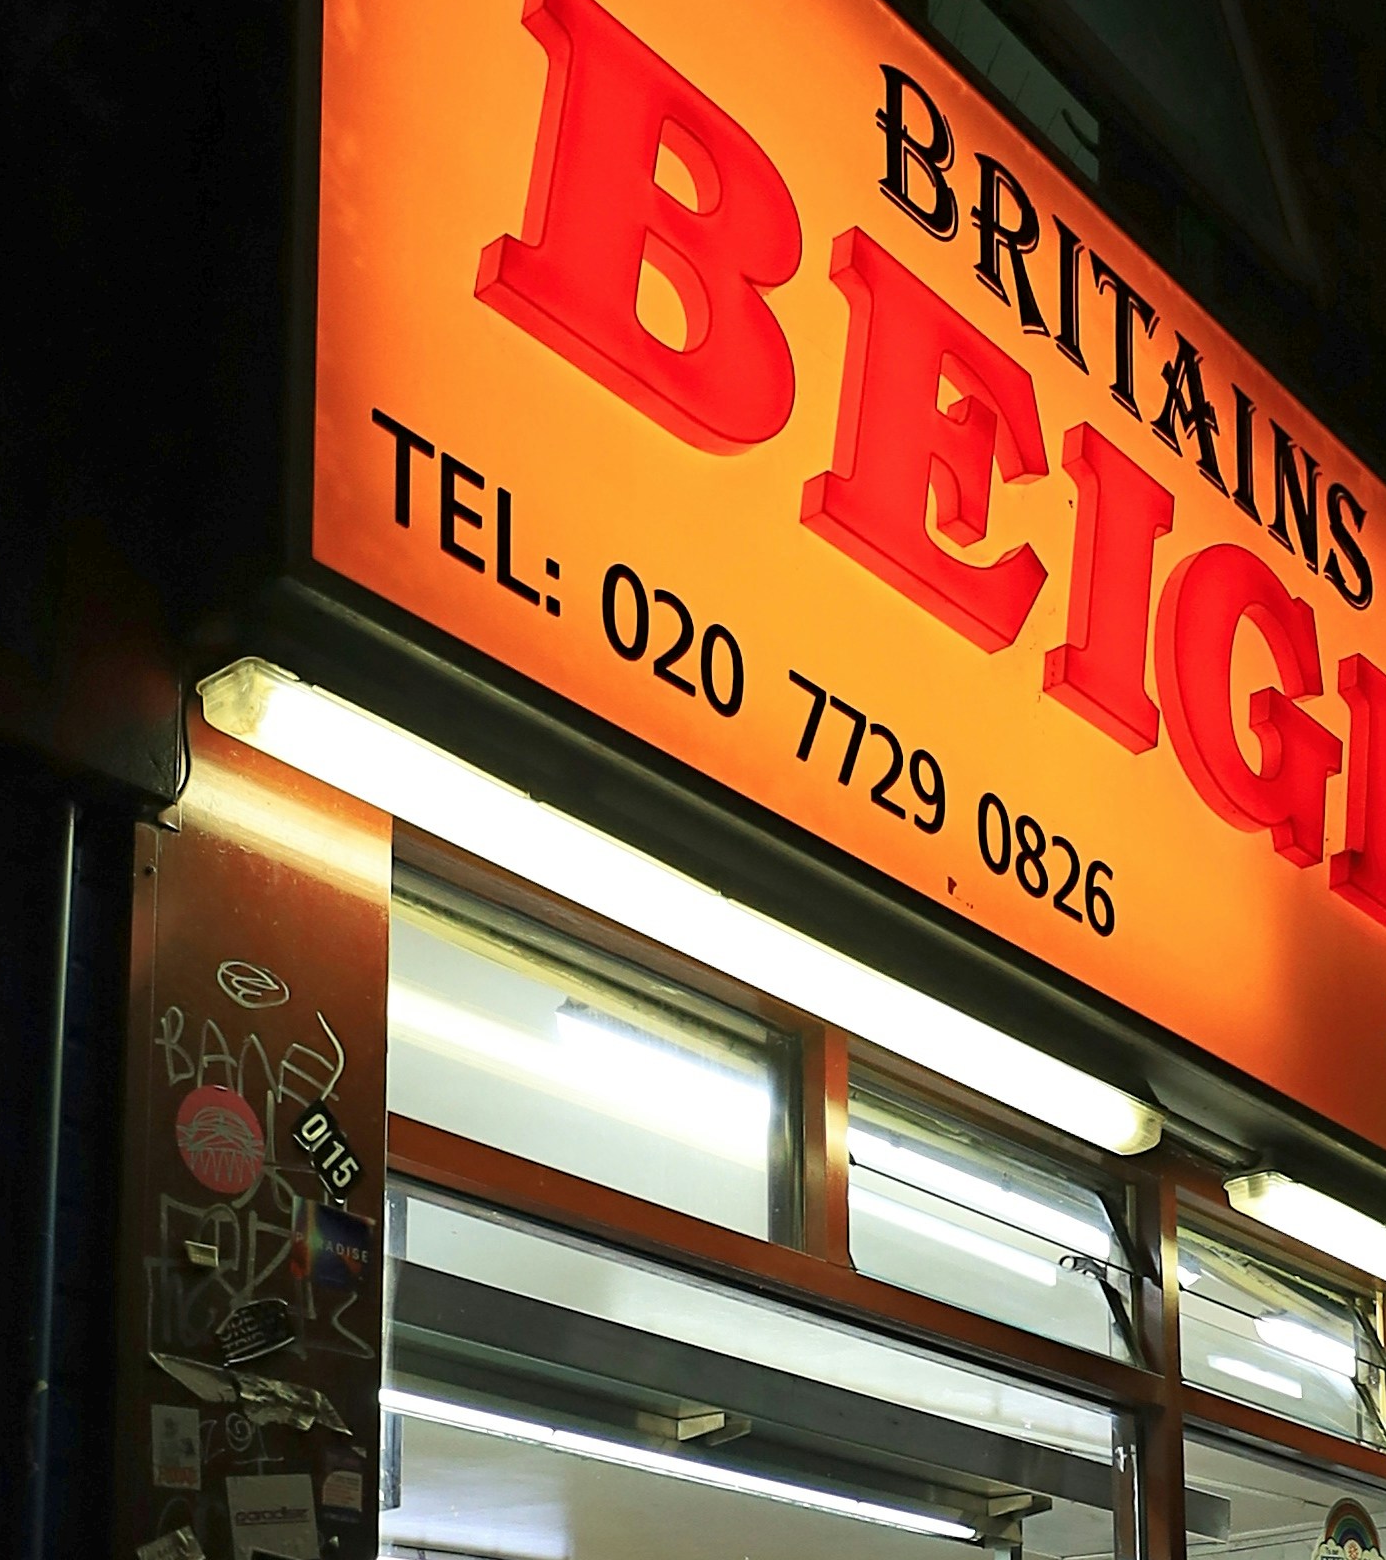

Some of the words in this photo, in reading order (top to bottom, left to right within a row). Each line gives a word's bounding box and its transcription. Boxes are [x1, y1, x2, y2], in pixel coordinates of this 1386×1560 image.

[876, 64, 1372, 610] BRITAINS
[372, 409, 562, 618] TEL:
[602, 561, 744, 719] 020
[789, 670, 946, 836] 7729
[977, 792, 1116, 939] 0826
